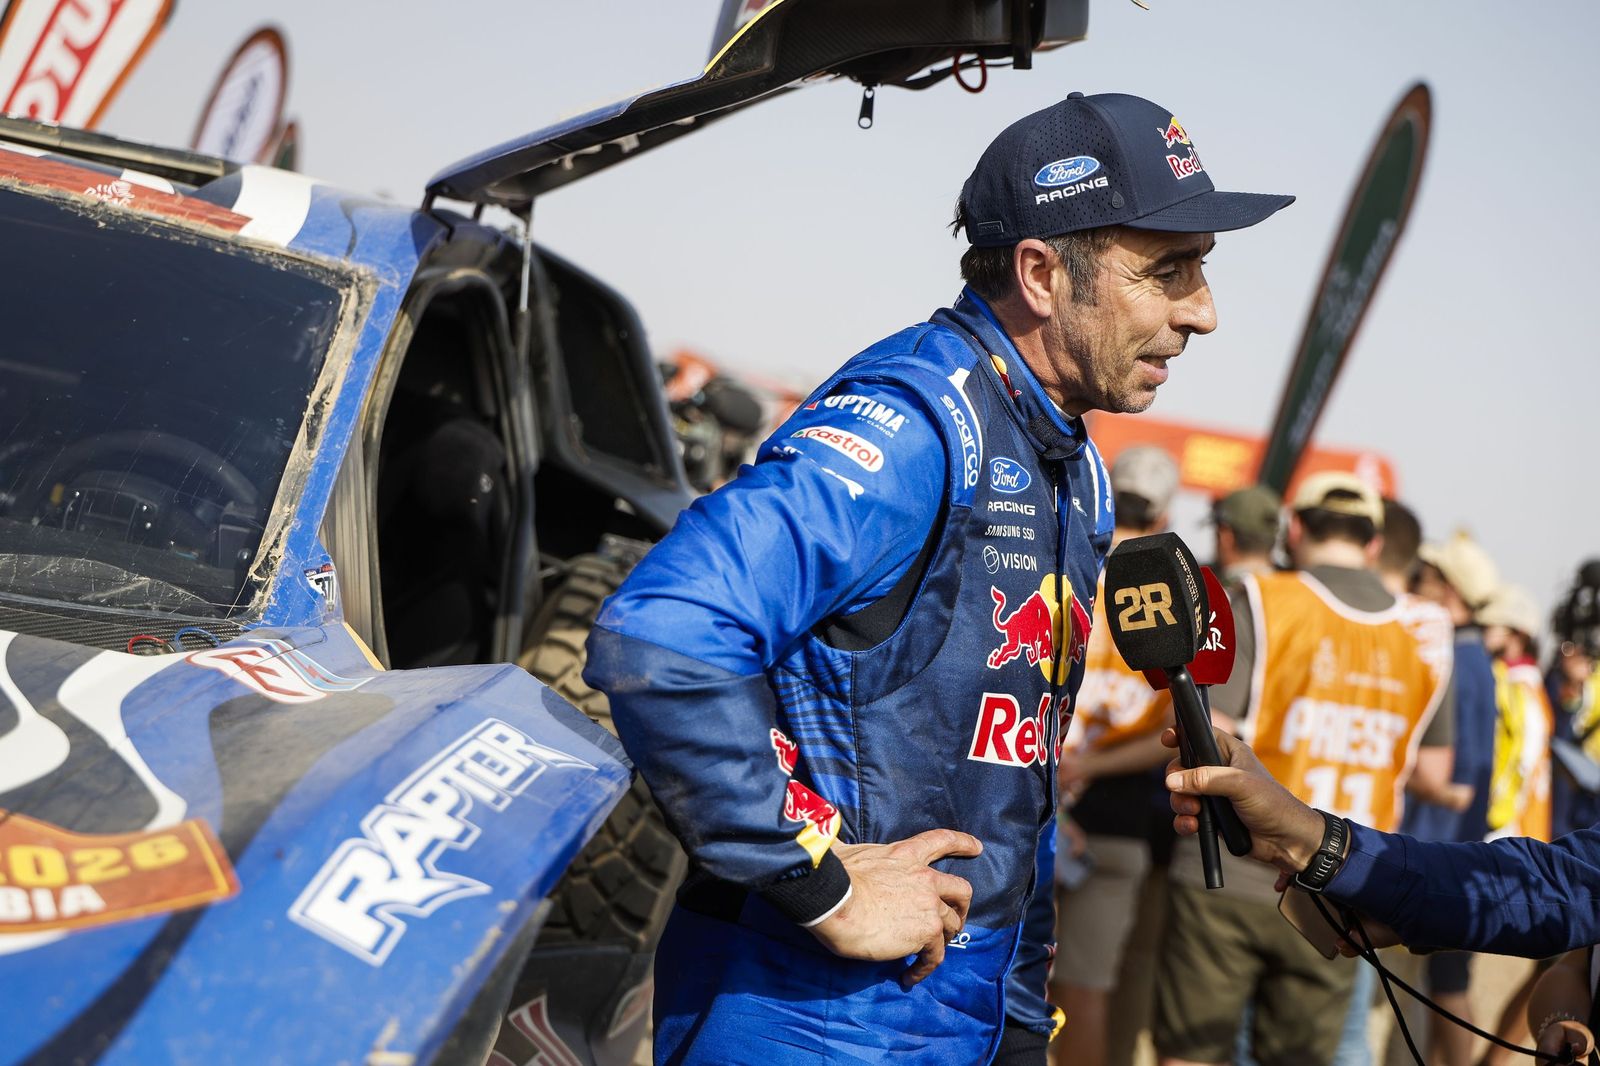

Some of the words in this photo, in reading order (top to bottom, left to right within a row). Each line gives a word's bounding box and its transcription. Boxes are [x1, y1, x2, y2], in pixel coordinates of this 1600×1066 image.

[1048, 161, 1086, 182] Ford
[1035, 176, 1109, 205] RACING
[824, 395, 905, 432] OPTIMA
[805, 428, 880, 467] Castrol
[940, 394, 979, 491] sparco
[992, 461, 1020, 489] Ford
[987, 501, 1036, 516] RACING
[984, 525, 1021, 538] SAMSUNG
[1022, 527, 1035, 541] SSD
[1001, 552, 1038, 572] VISION
[1114, 582, 1178, 632] 2R
[288, 717, 598, 967] RAPTOR
[0, 835, 188, 887] 026
